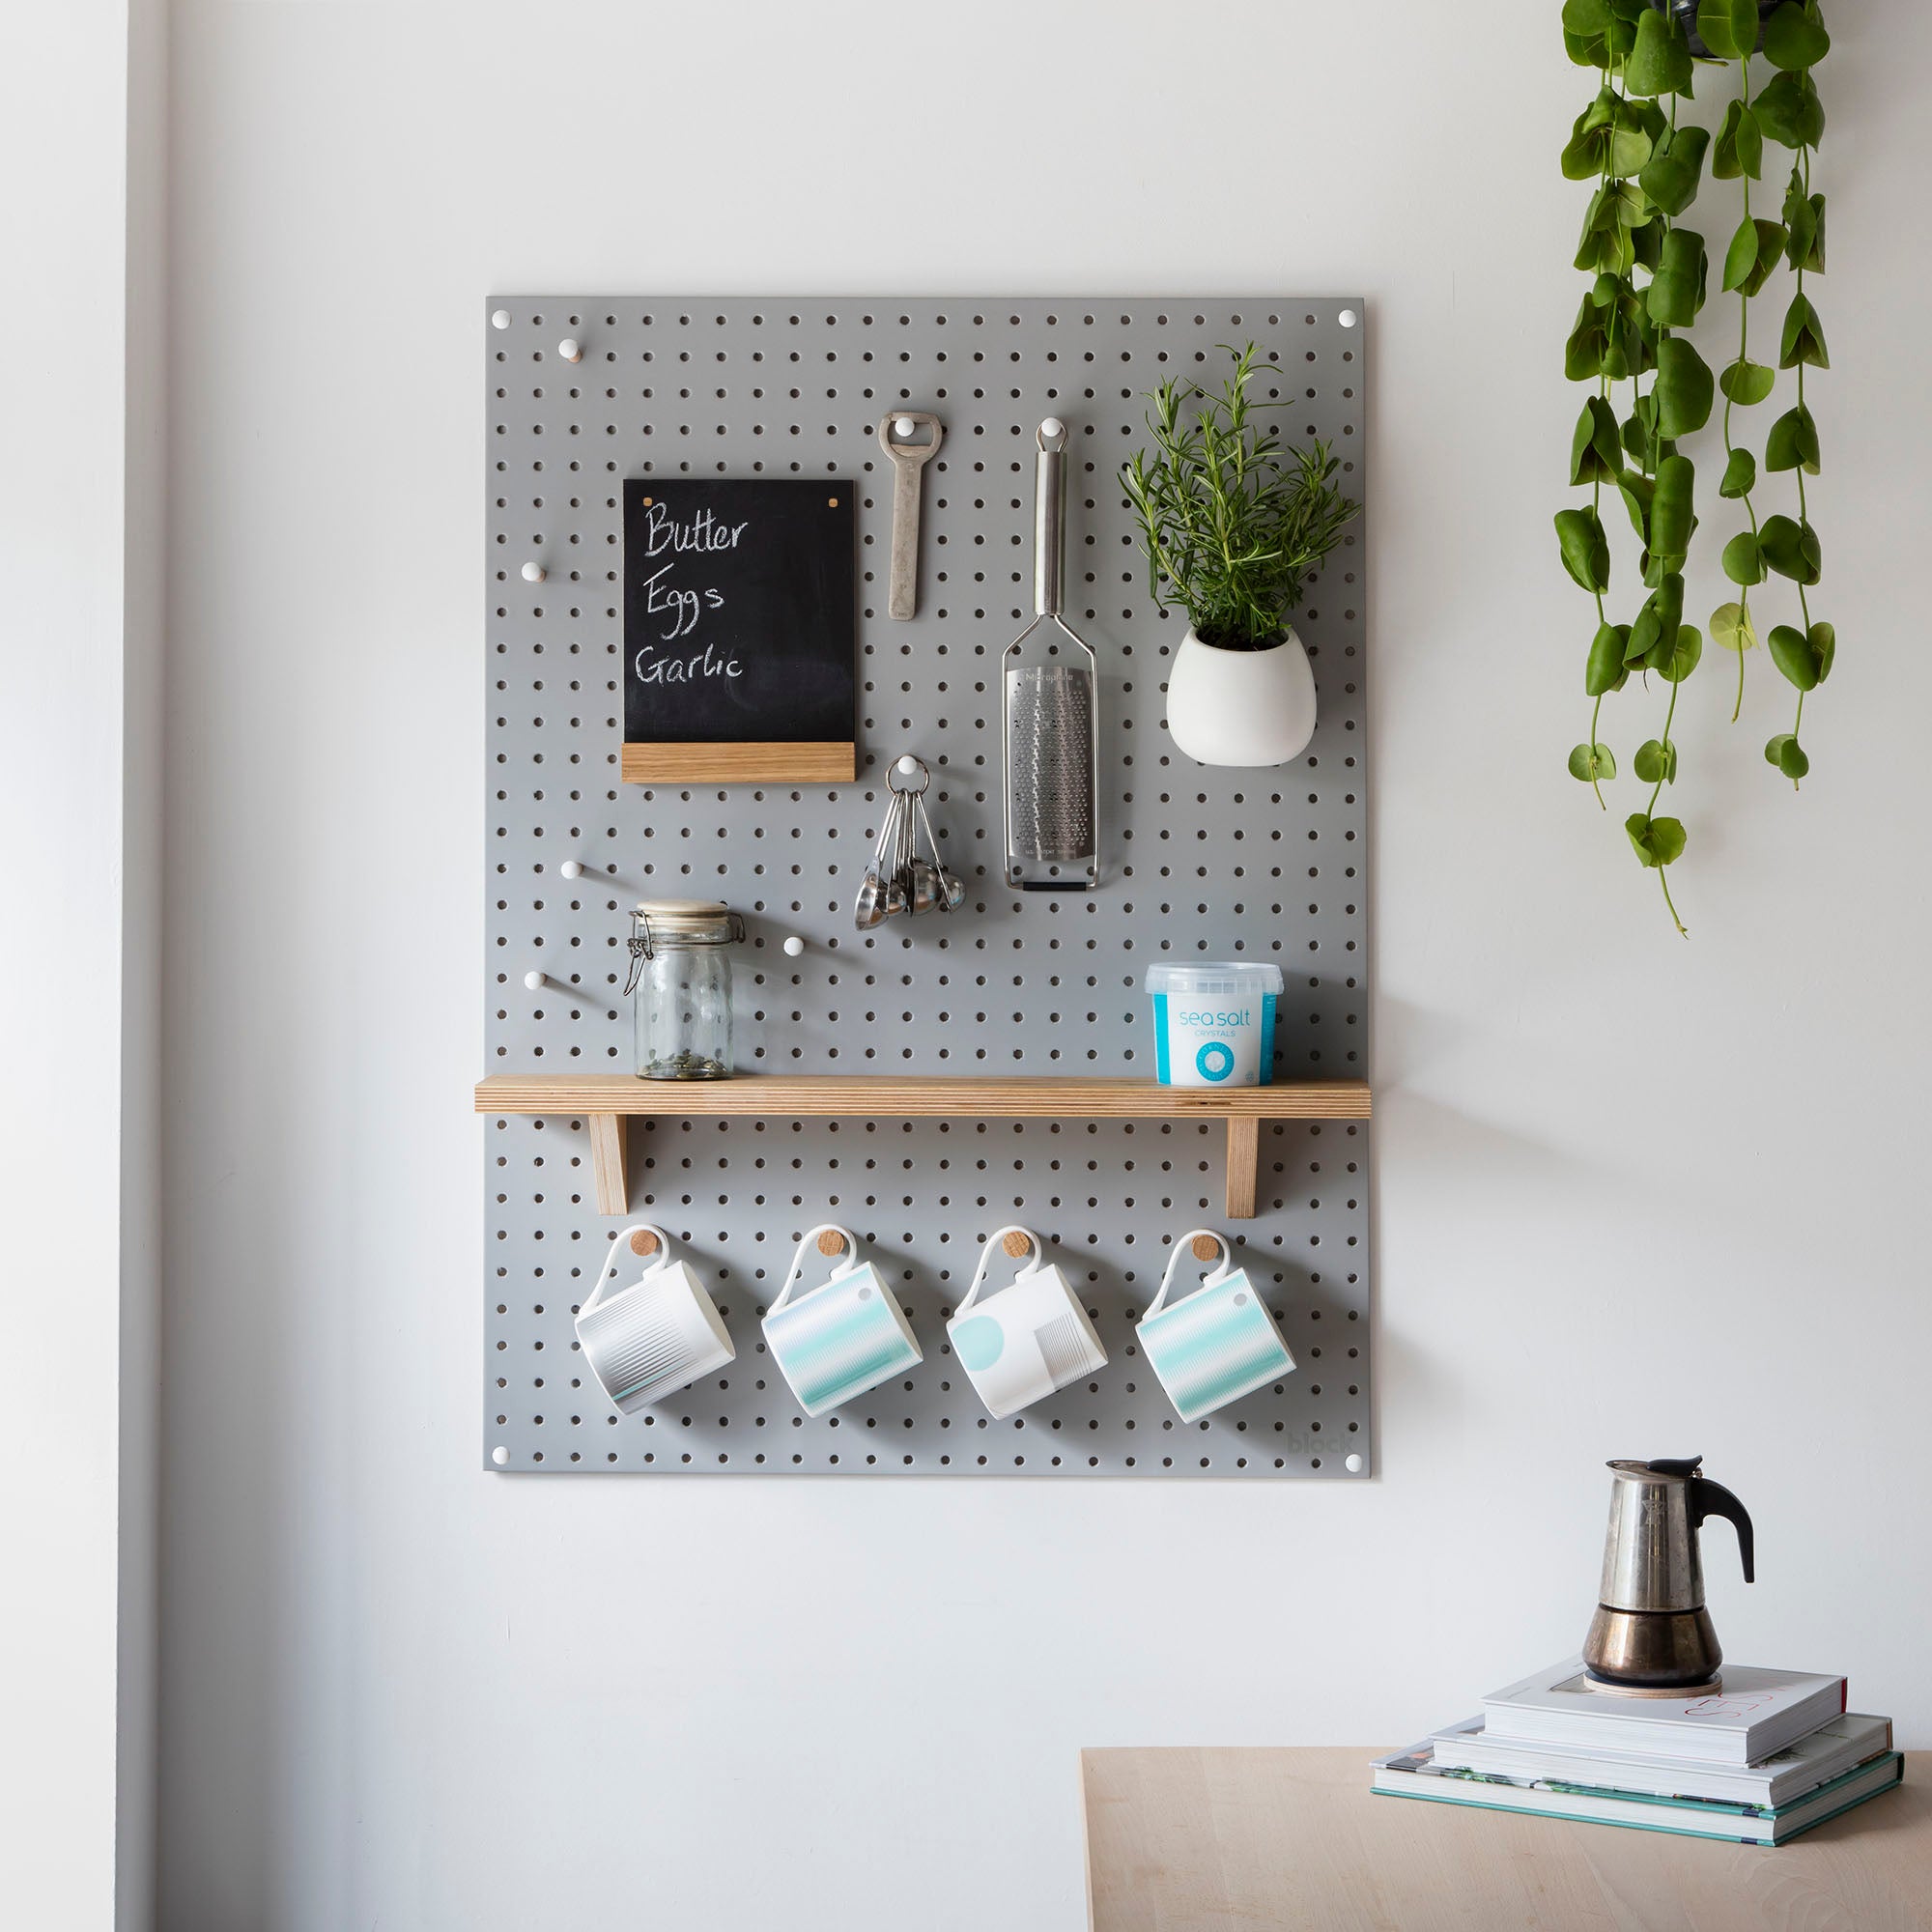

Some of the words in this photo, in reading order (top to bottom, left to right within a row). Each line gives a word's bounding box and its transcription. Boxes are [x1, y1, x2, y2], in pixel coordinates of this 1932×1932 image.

[644, 502, 749, 556] Butter
[642, 562, 724, 640] Eggs
[635, 643, 743, 687] Garlic
[1179, 1011, 1213, 1026] sea
[1217, 1009, 1251, 1026] salt
